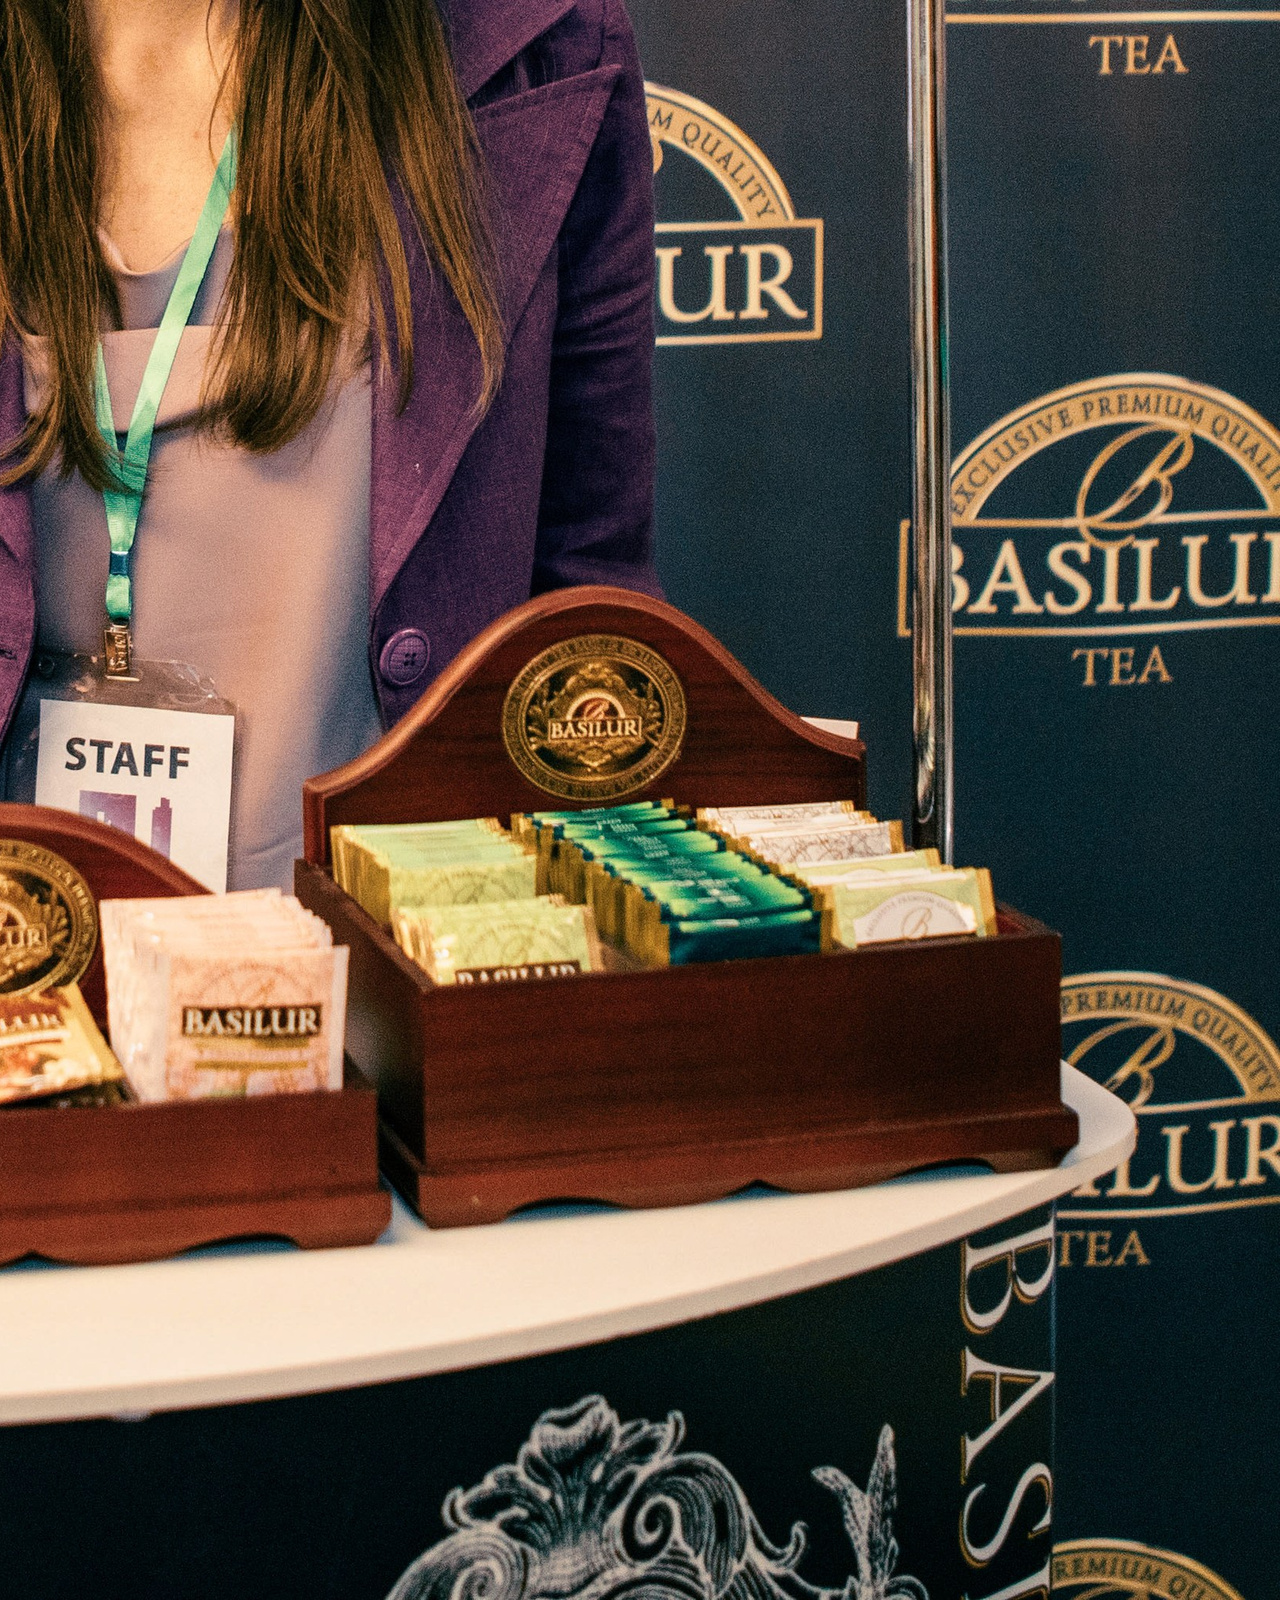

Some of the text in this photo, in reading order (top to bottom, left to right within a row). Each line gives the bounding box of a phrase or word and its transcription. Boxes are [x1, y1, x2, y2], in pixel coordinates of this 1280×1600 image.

[1089, 34, 1189, 75] TEA
[682, 122, 776, 219] QUALITY
[1081, 394, 1204, 425] PREMIUM
[1071, 645, 1173, 687] TEA
[551, 720, 638, 739] BASILUR
[64, 737, 190, 779] STAFF
[186, 1007, 318, 1036] BASILUR
[1056, 1231, 1150, 1267] TEA
[1052, 1557, 1162, 1586] REMIUM
